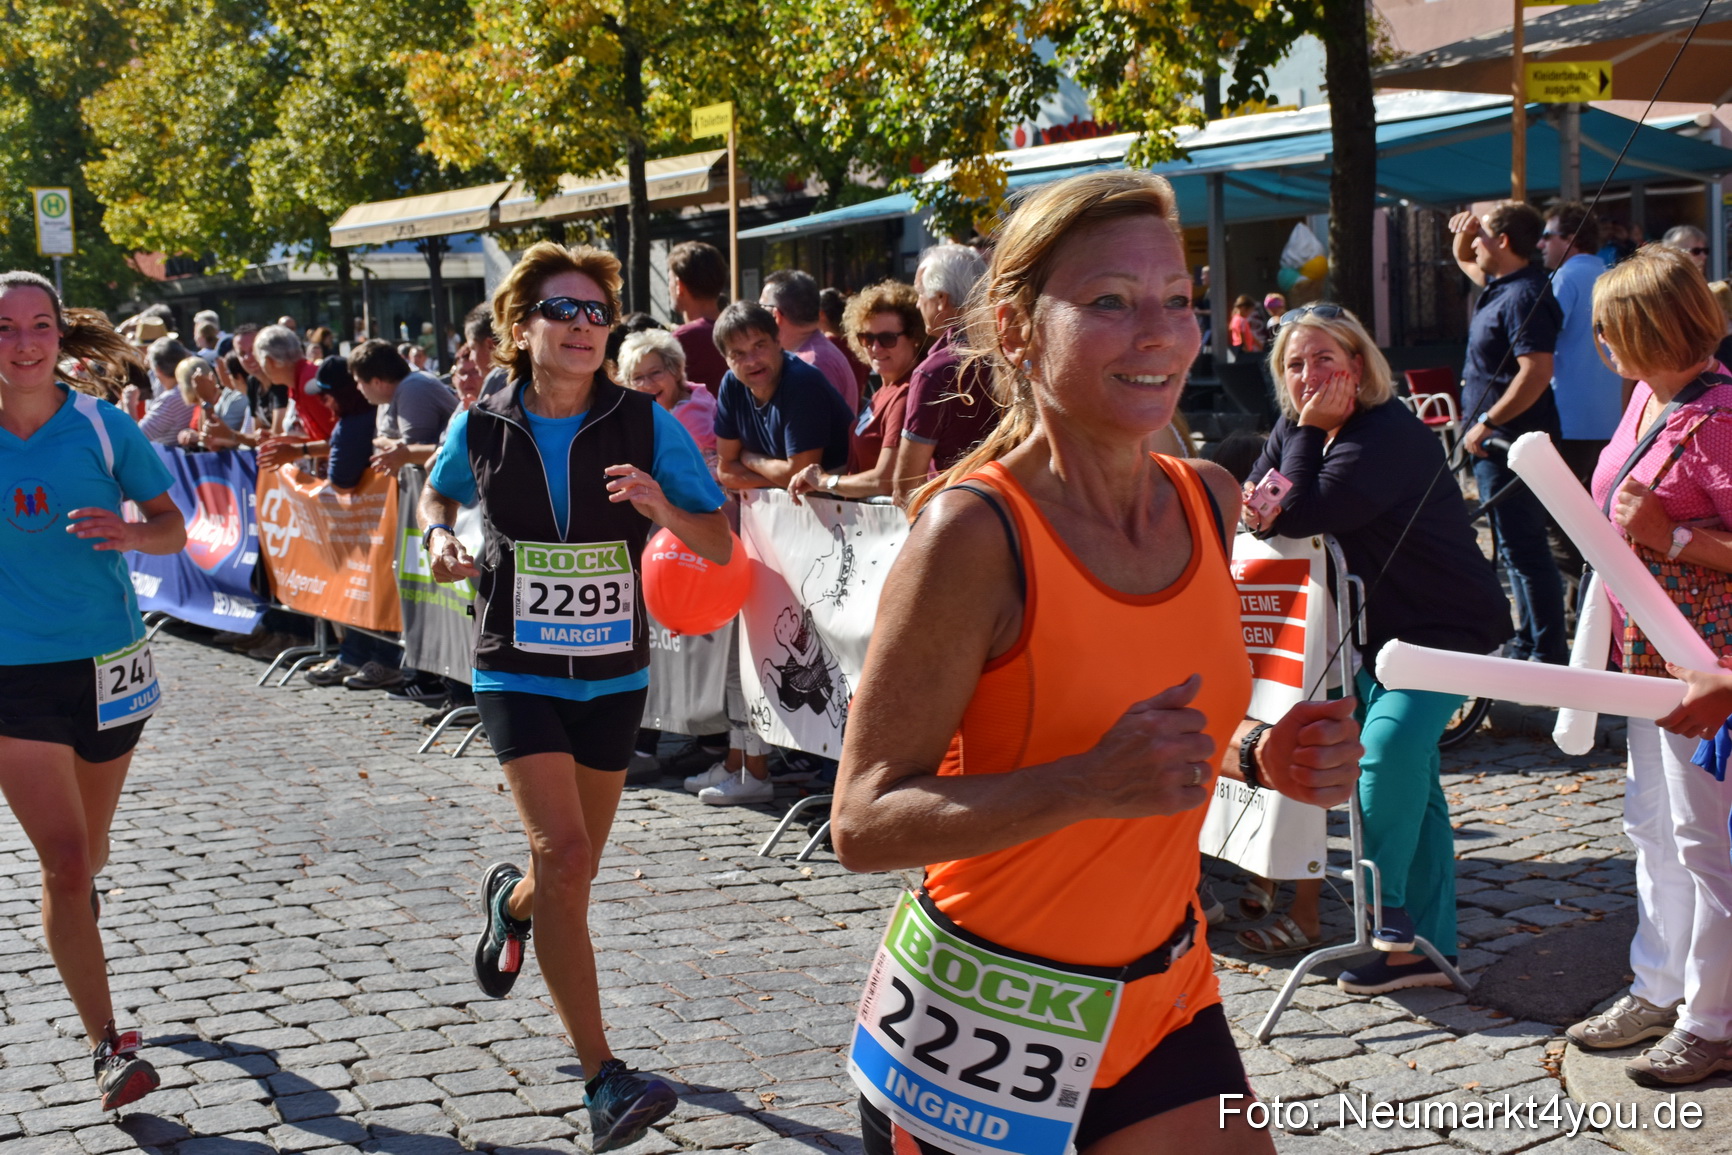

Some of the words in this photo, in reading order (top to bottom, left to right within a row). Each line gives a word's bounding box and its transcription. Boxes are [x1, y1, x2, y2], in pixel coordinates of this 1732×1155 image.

[1544, 85, 1580, 98] ausgabe
[700, 114, 728, 128] Toiletten
[1041, 114, 1118, 145] voda
[525, 546, 623, 574] BOCK
[286, 569, 328, 596] Agentur
[529, 581, 621, 617] 2293
[1240, 595, 1281, 612] TEME
[540, 627, 612, 643] MARGIT
[1242, 626, 1274, 645] GEN
[896, 912, 1096, 1032] BOCK
[878, 976, 1063, 1103] 2223
[884, 1066, 1010, 1141] INGRID
